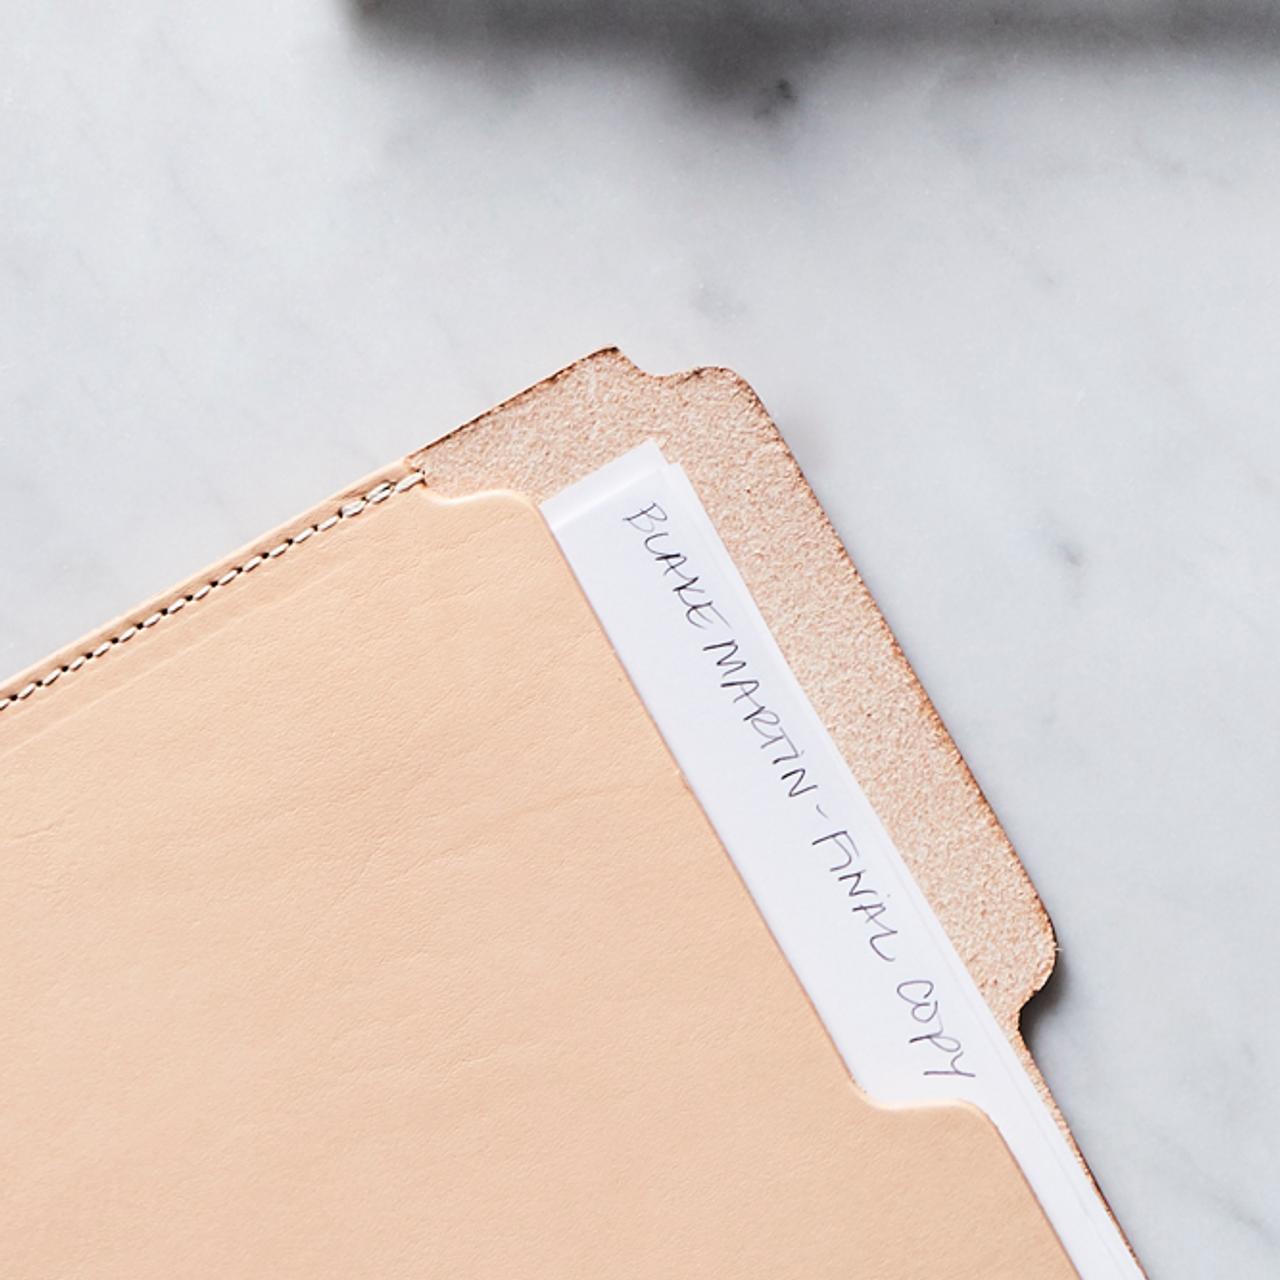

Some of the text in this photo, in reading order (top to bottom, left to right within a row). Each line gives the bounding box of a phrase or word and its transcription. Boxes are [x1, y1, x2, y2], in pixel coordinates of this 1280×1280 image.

[624, 501, 977, 1078] BLAKE MARTIN FINAL COPY
